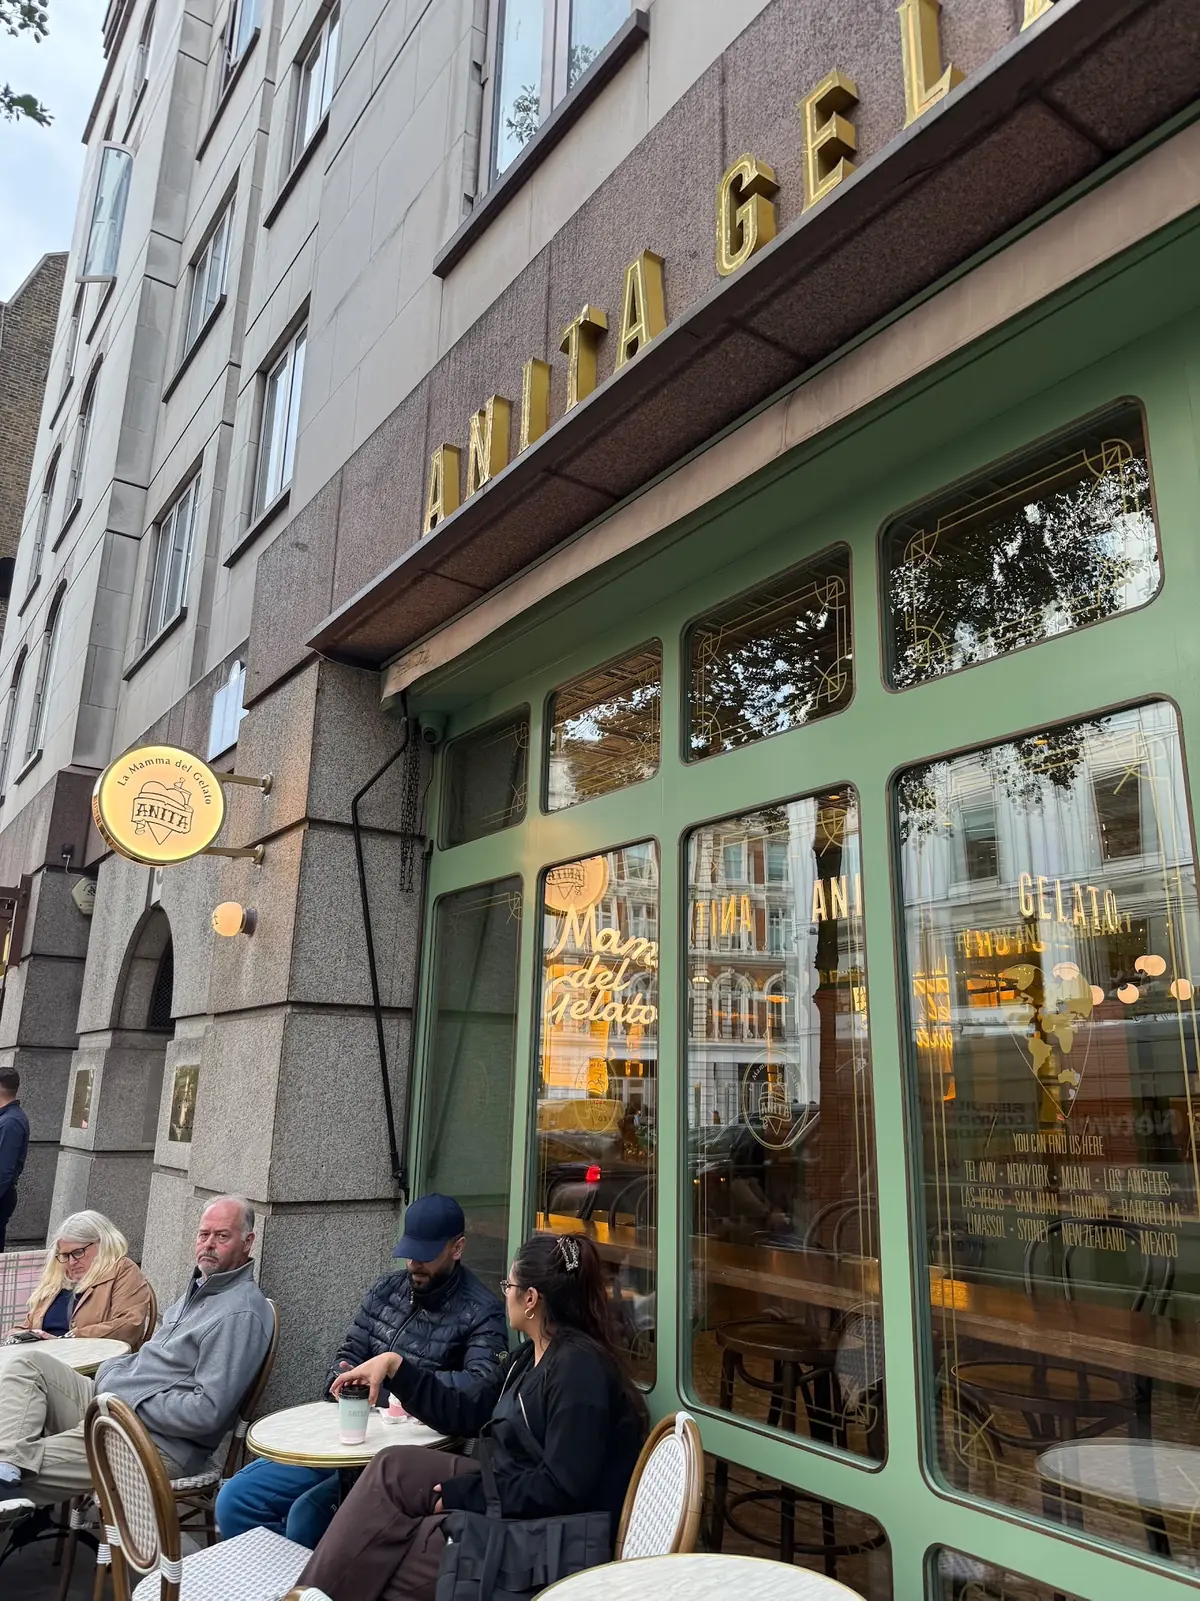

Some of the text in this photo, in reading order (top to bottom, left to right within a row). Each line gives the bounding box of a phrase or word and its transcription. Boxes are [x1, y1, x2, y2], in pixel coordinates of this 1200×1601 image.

[422, 0, 1054, 536] ANITA GEL
[117, 757, 213, 806] La Mamma del Gelato
[135, 802, 189, 829] ANITA
[1018, 870, 1118, 932] GELATO
[570, 954, 632, 992] del
[544, 975, 658, 1025] Gelato
[761, 1102, 790, 1118] ANITA
[1012, 1132, 1030, 1153] YOU
[1031, 1134, 1047, 1154] CAN
[1049, 1135, 1067, 1155] FIND
[1069, 1135, 1081, 1155] US
[1082, 1135, 1104, 1156] HERE
[964, 1160, 978, 1182] TEL
[979, 1161, 996, 1183] AVIV
[1061, 1165, 1091, 1190] MIAMI
[1103, 1168, 1122, 1192] LOS
[1127, 1168, 1171, 1196] ANGELES
[961, 1185, 976, 1209] LAS
[978, 1187, 1005, 1211] VEGAS
[1015, 1190, 1033, 1214] SAN
[1035, 1191, 1059, 1216] JUAN
[1070, 1194, 1109, 1220] LONDON
[967, 1212, 1007, 1239] LIMASSOL
[1017, 1217, 1049, 1243] SYDNEY
[1140, 1229, 1179, 1259] MEXICO
